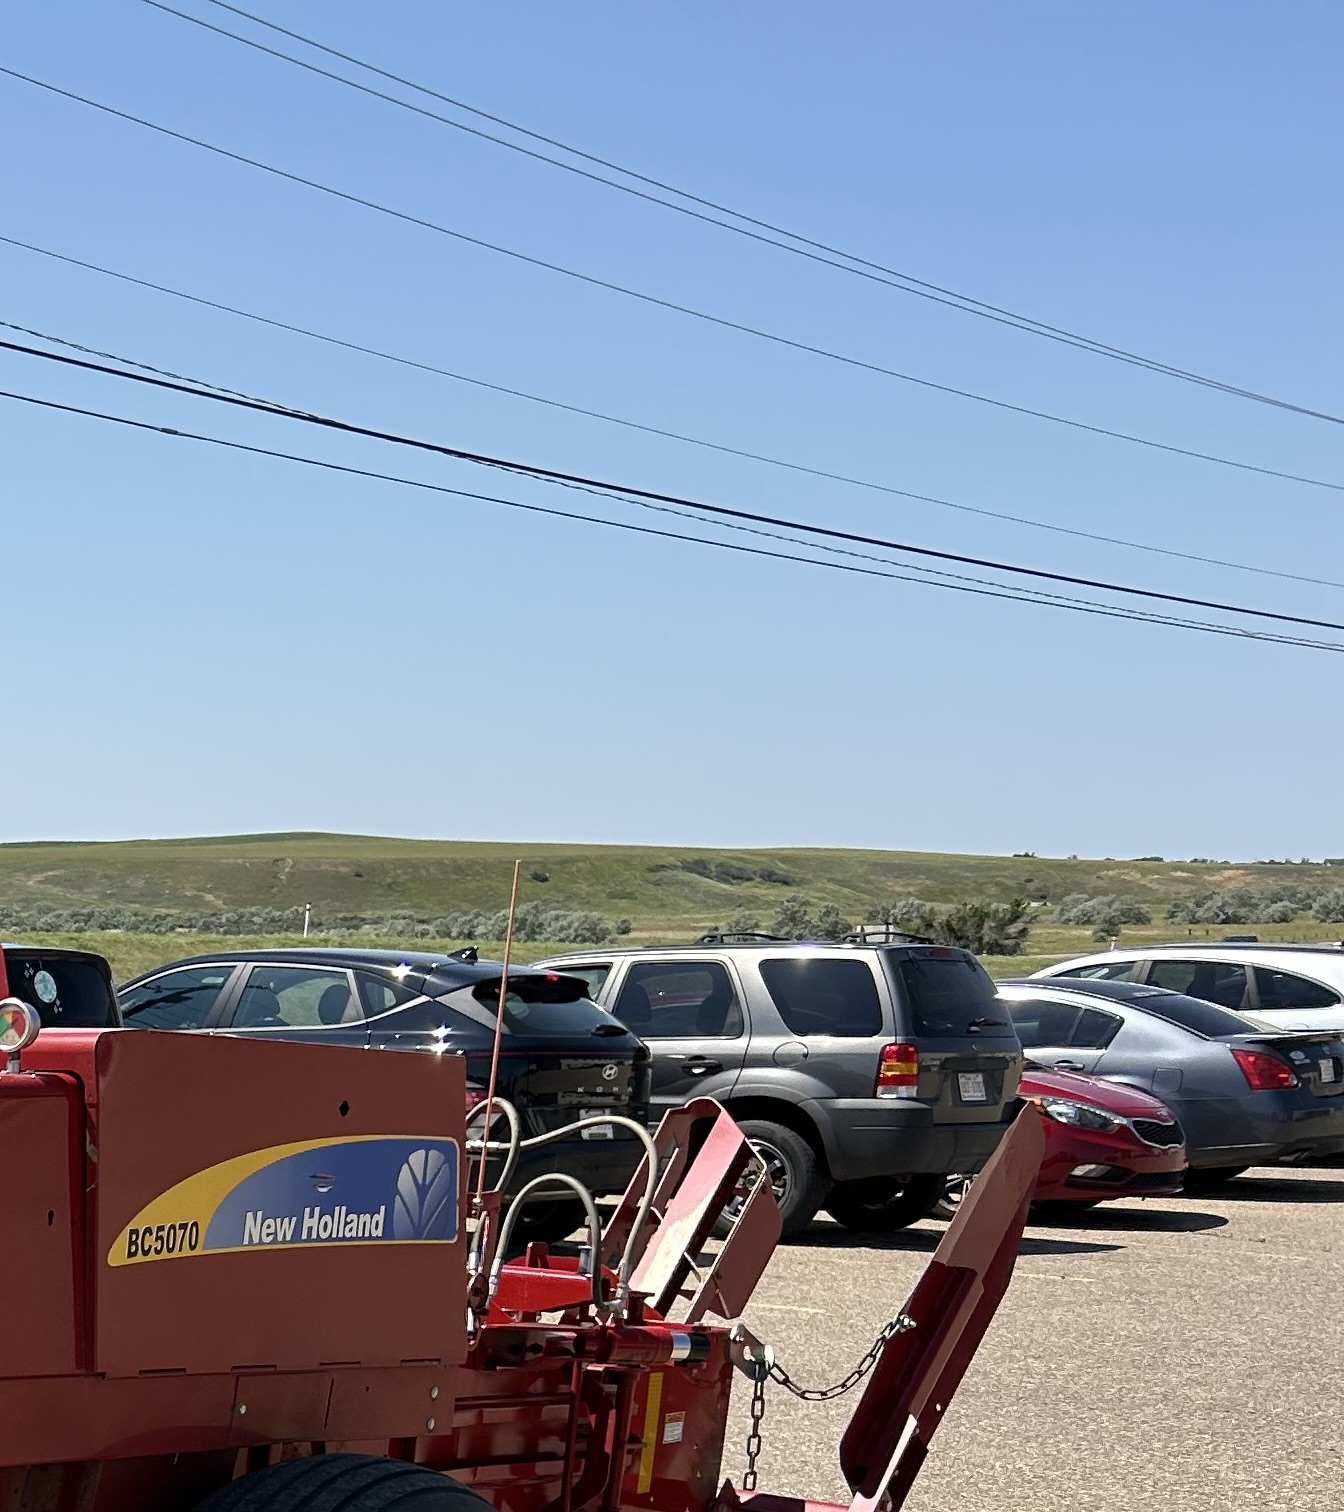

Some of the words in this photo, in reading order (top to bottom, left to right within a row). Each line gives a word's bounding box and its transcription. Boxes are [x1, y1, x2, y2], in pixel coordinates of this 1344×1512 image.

[125, 1220, 200, 1259] BC5070
[242, 1210, 297, 1245] New
[301, 1204, 386, 1240] Holland
